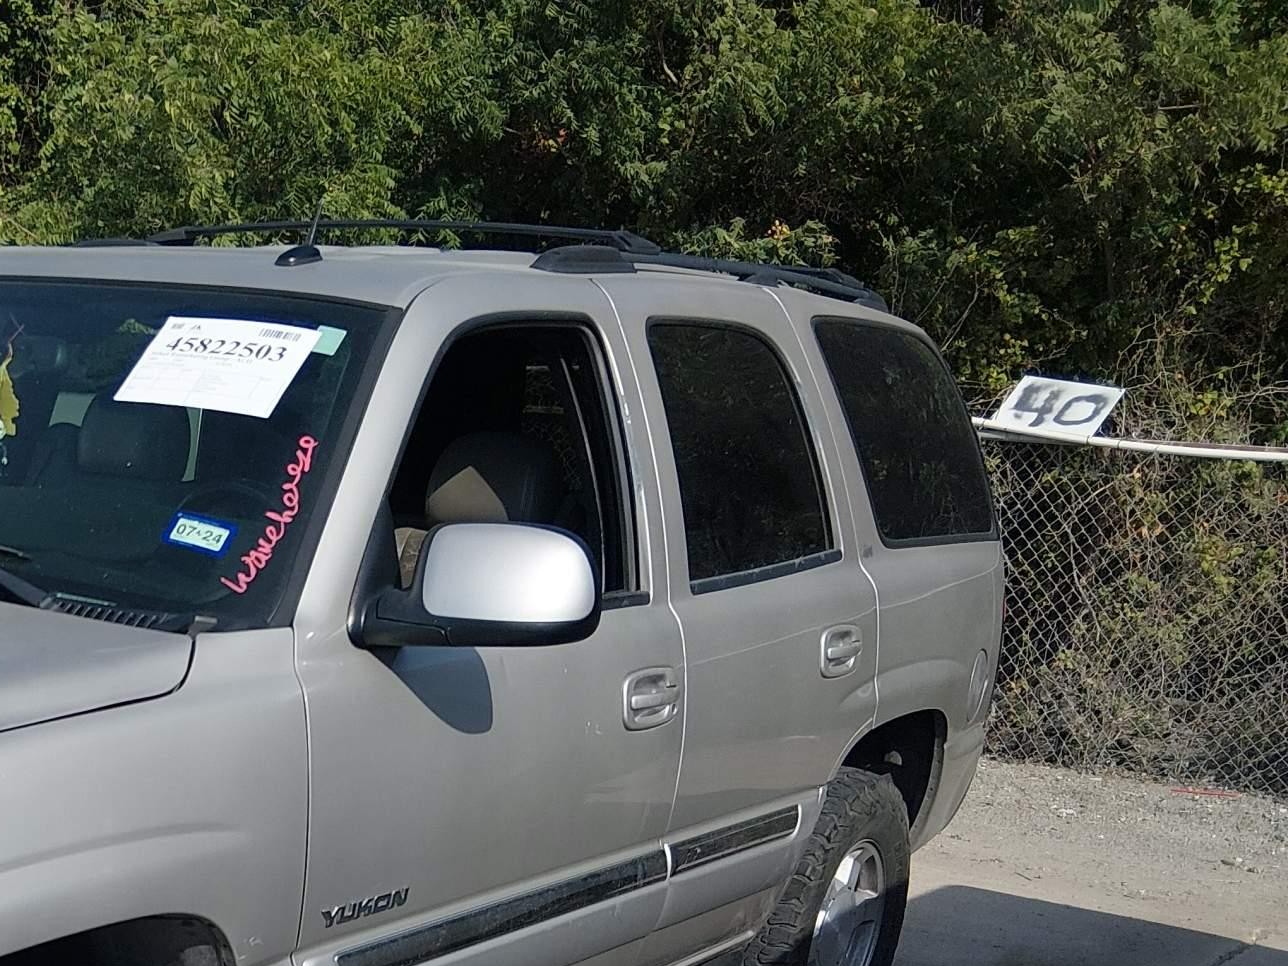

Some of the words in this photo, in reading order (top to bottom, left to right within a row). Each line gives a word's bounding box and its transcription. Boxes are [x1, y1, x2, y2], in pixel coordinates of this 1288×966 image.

[165, 335, 288, 363] 45822503
[1009, 382, 1109, 427] 40
[320, 886, 410, 928] YUKON
